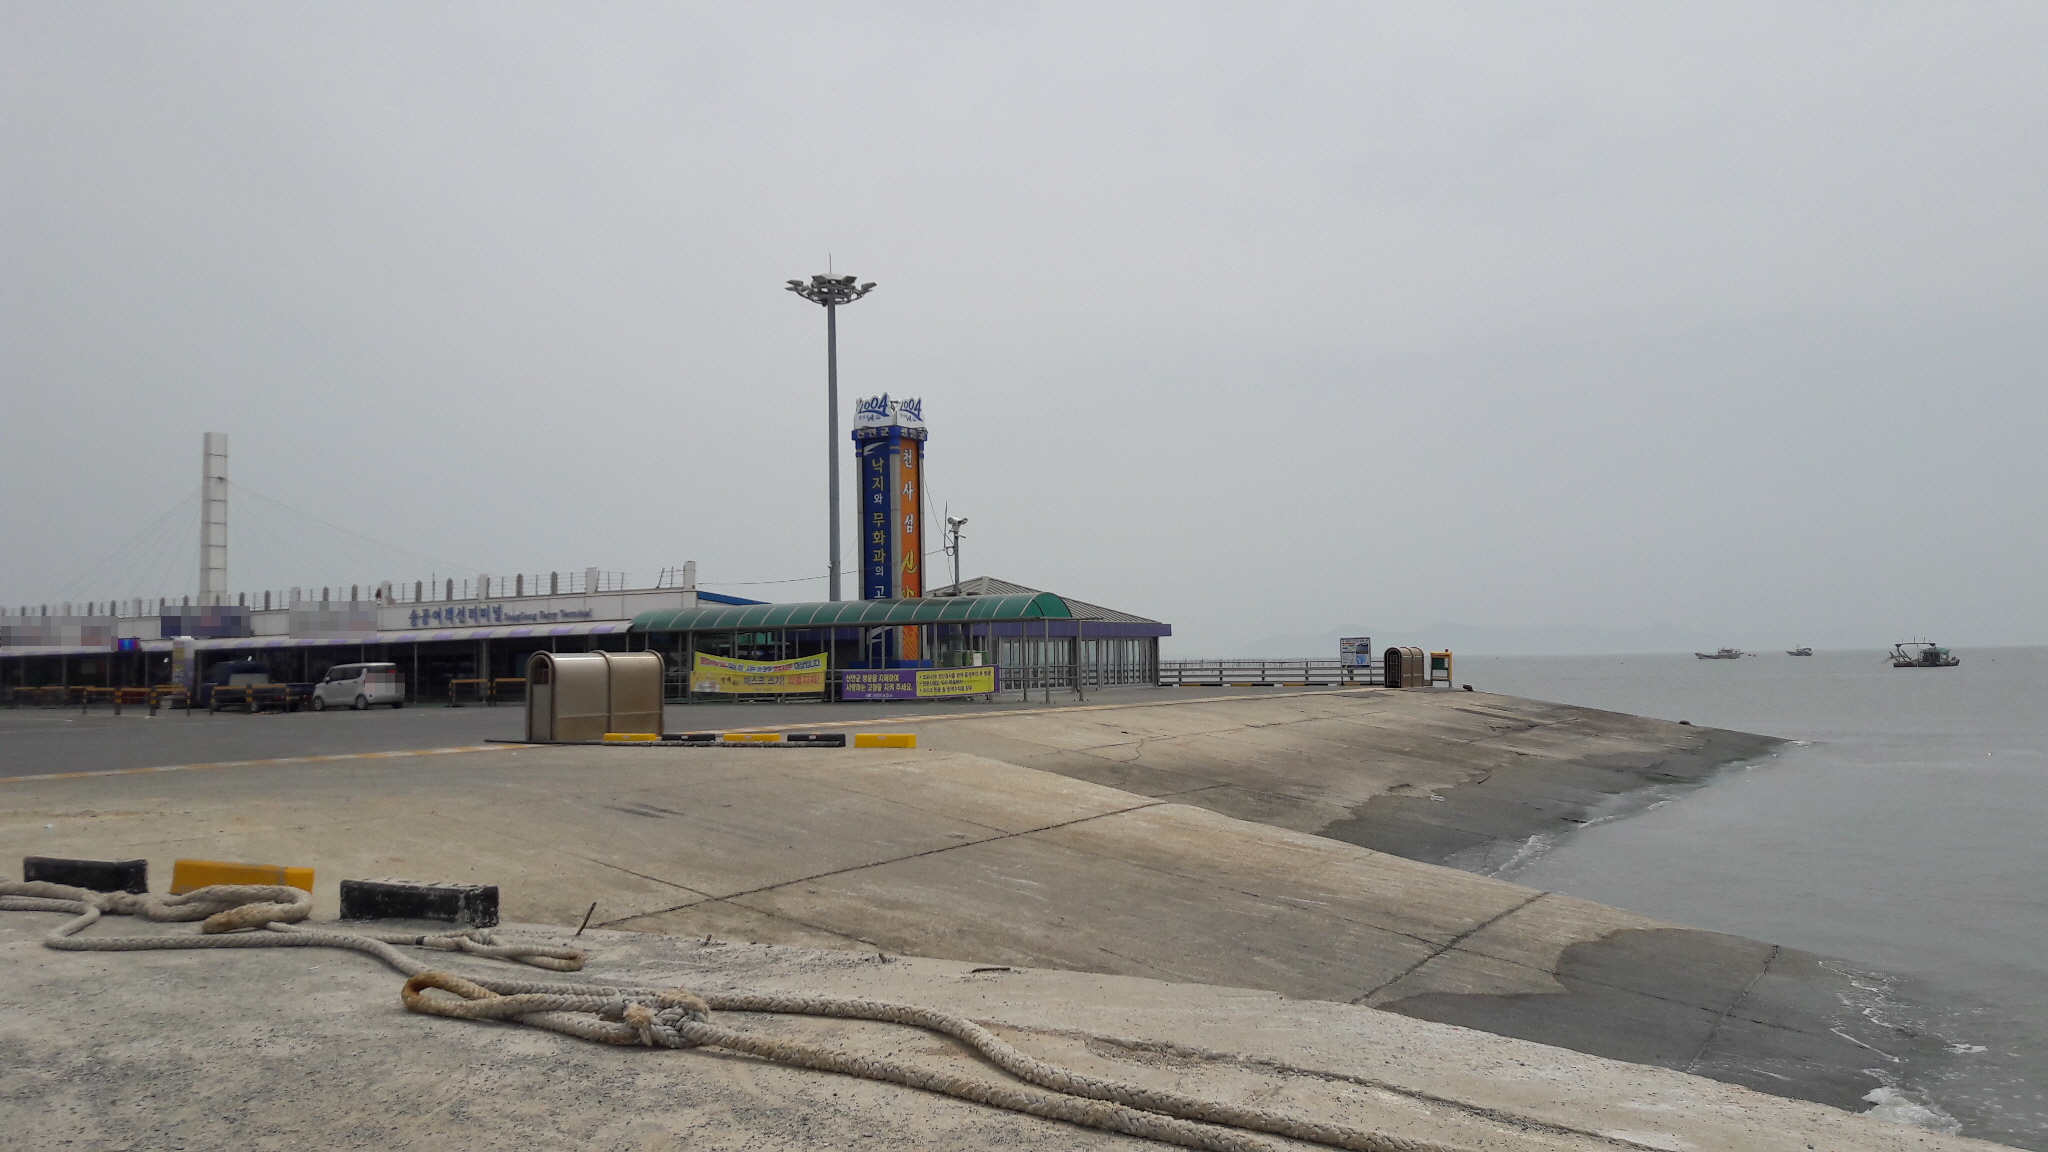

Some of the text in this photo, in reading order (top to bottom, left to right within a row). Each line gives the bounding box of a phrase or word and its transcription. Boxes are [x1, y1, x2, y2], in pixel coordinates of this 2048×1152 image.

[902, 448, 915, 534] 천사섬
[871, 457, 887, 599] 낙지와 무화과의 고
[408, 604, 502, 628] 송공여객선터미널
[743, 675, 764, 685] 마스크
